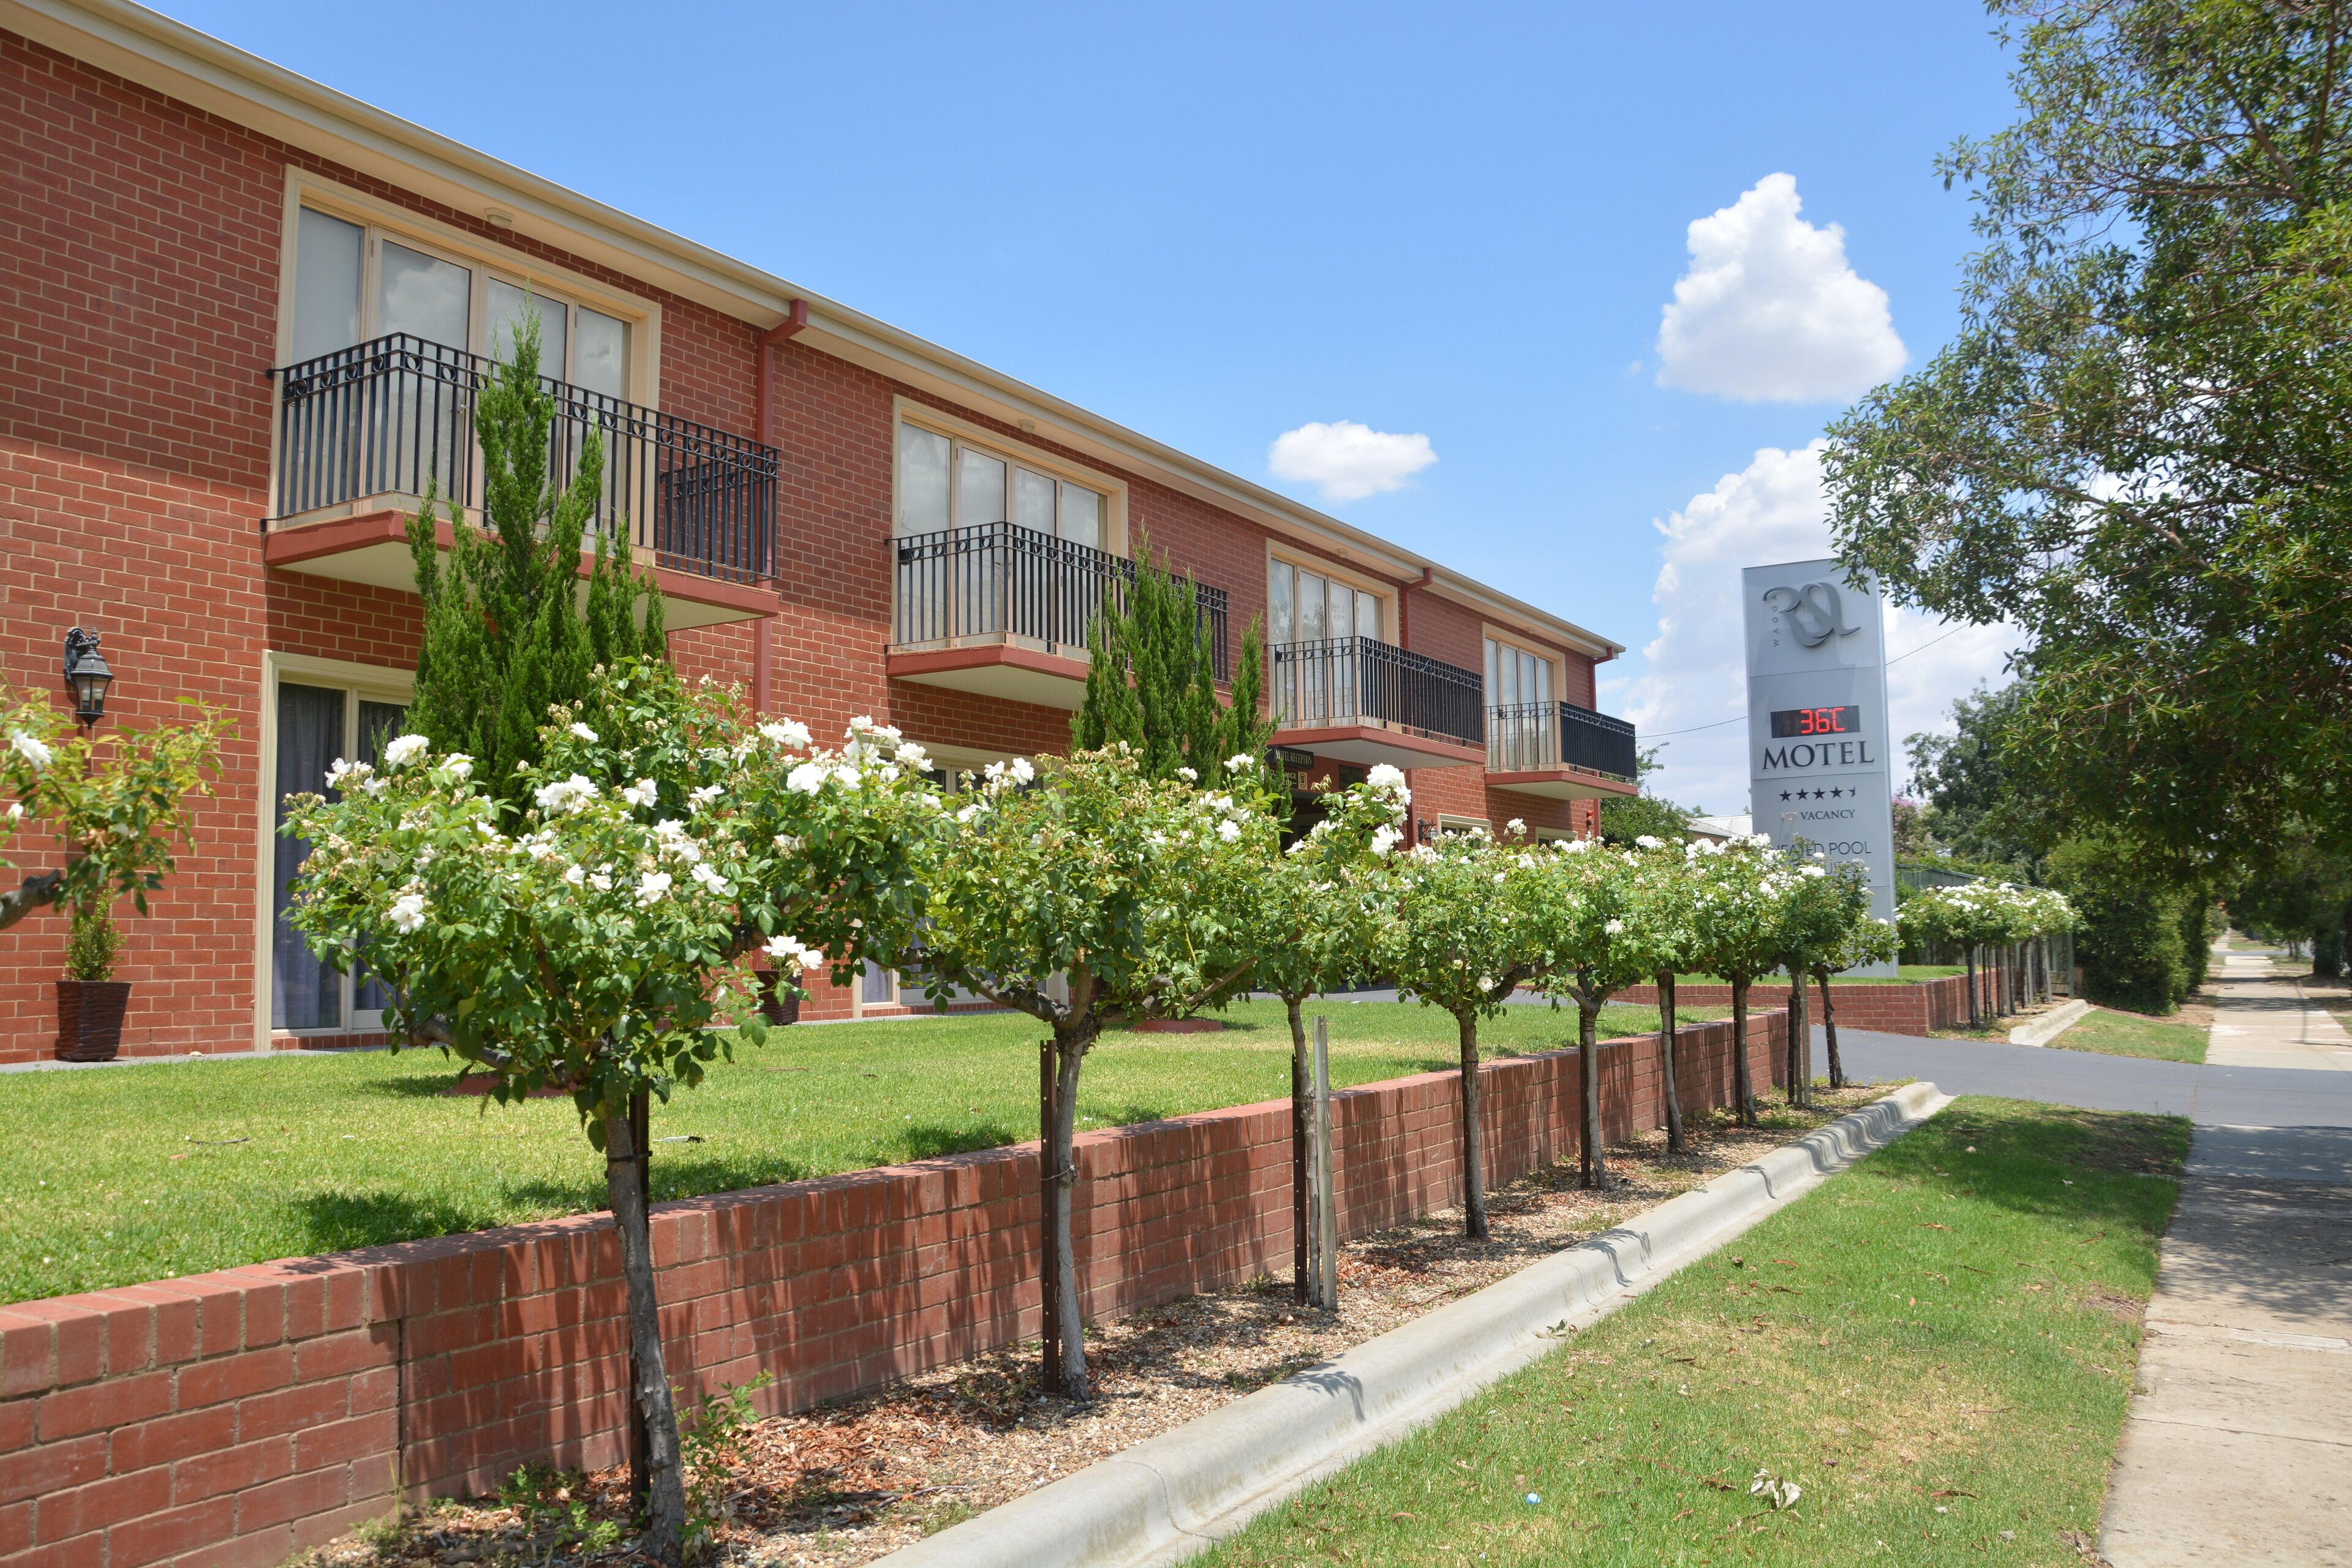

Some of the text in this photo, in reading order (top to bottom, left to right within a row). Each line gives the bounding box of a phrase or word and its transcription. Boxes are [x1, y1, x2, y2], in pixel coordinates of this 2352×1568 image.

[1290, 752, 1312, 764] RECEPTION
[1762, 740, 1875, 769] MOTEL
[1800, 809, 1856, 820] VACANCY
[1829, 842, 1872, 855] POOL
